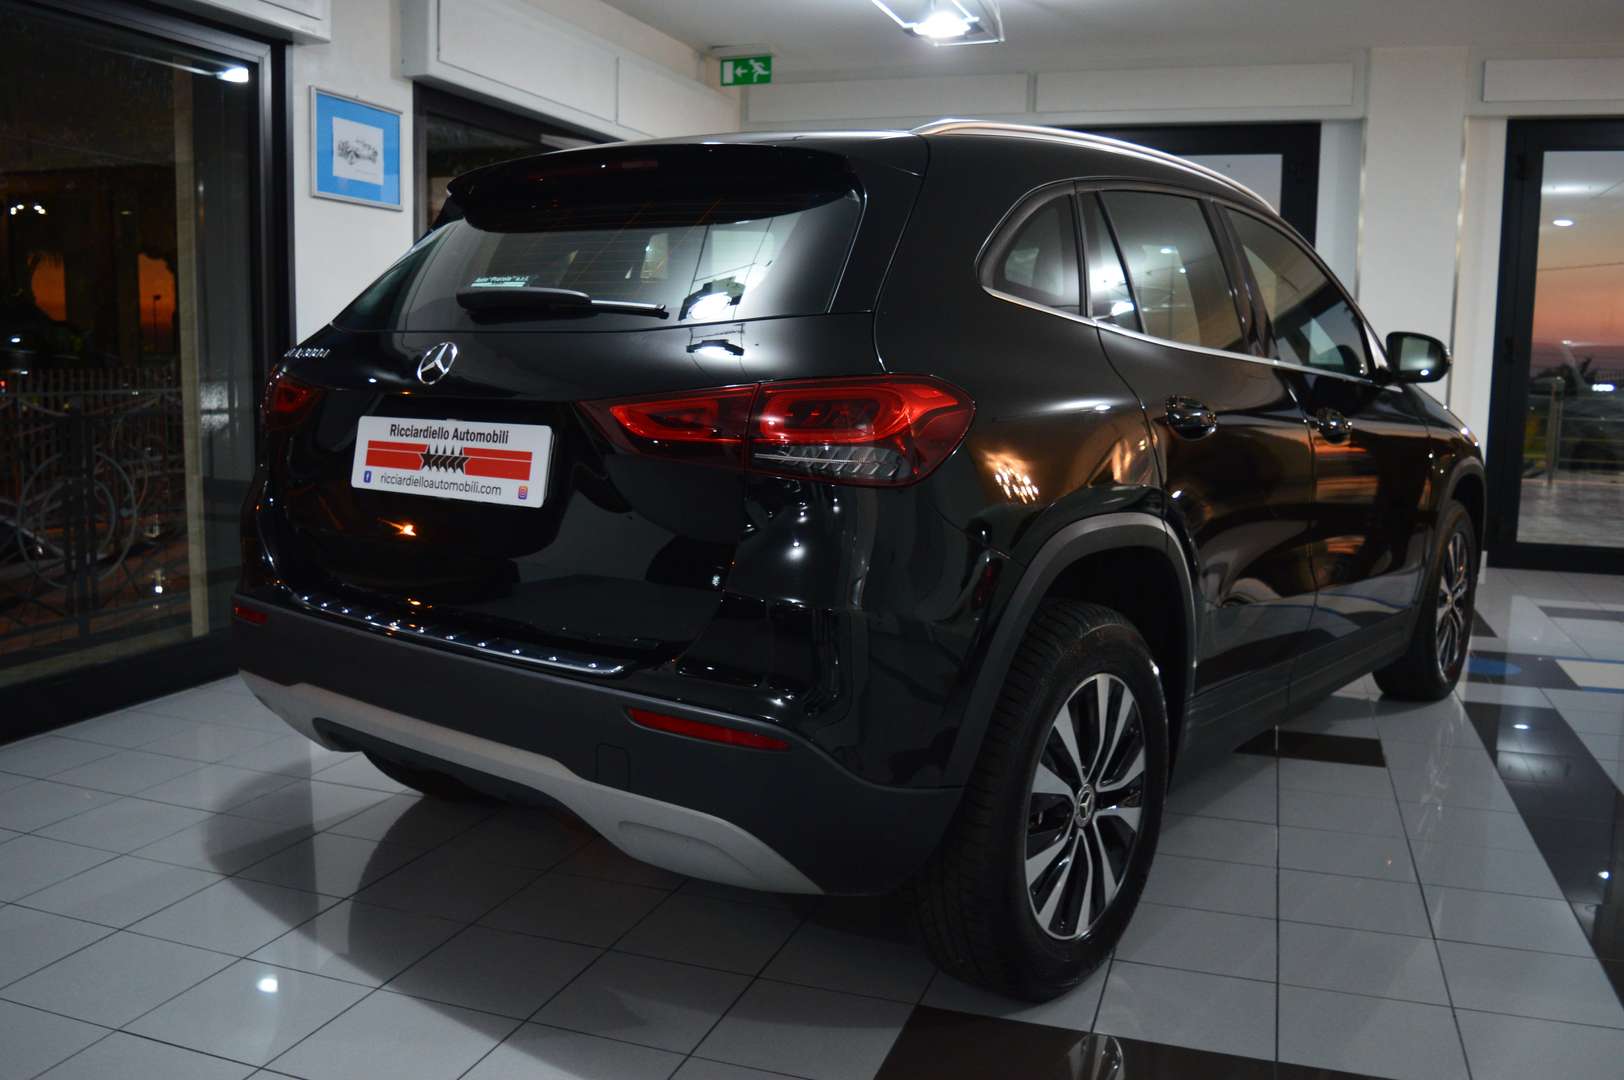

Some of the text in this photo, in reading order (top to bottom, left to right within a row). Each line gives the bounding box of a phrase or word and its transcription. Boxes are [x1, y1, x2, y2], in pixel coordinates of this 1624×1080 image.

[389, 424, 510, 445] Ricciardiello Automobili
[380, 473, 502, 496] ricciardielloautomobili.com
